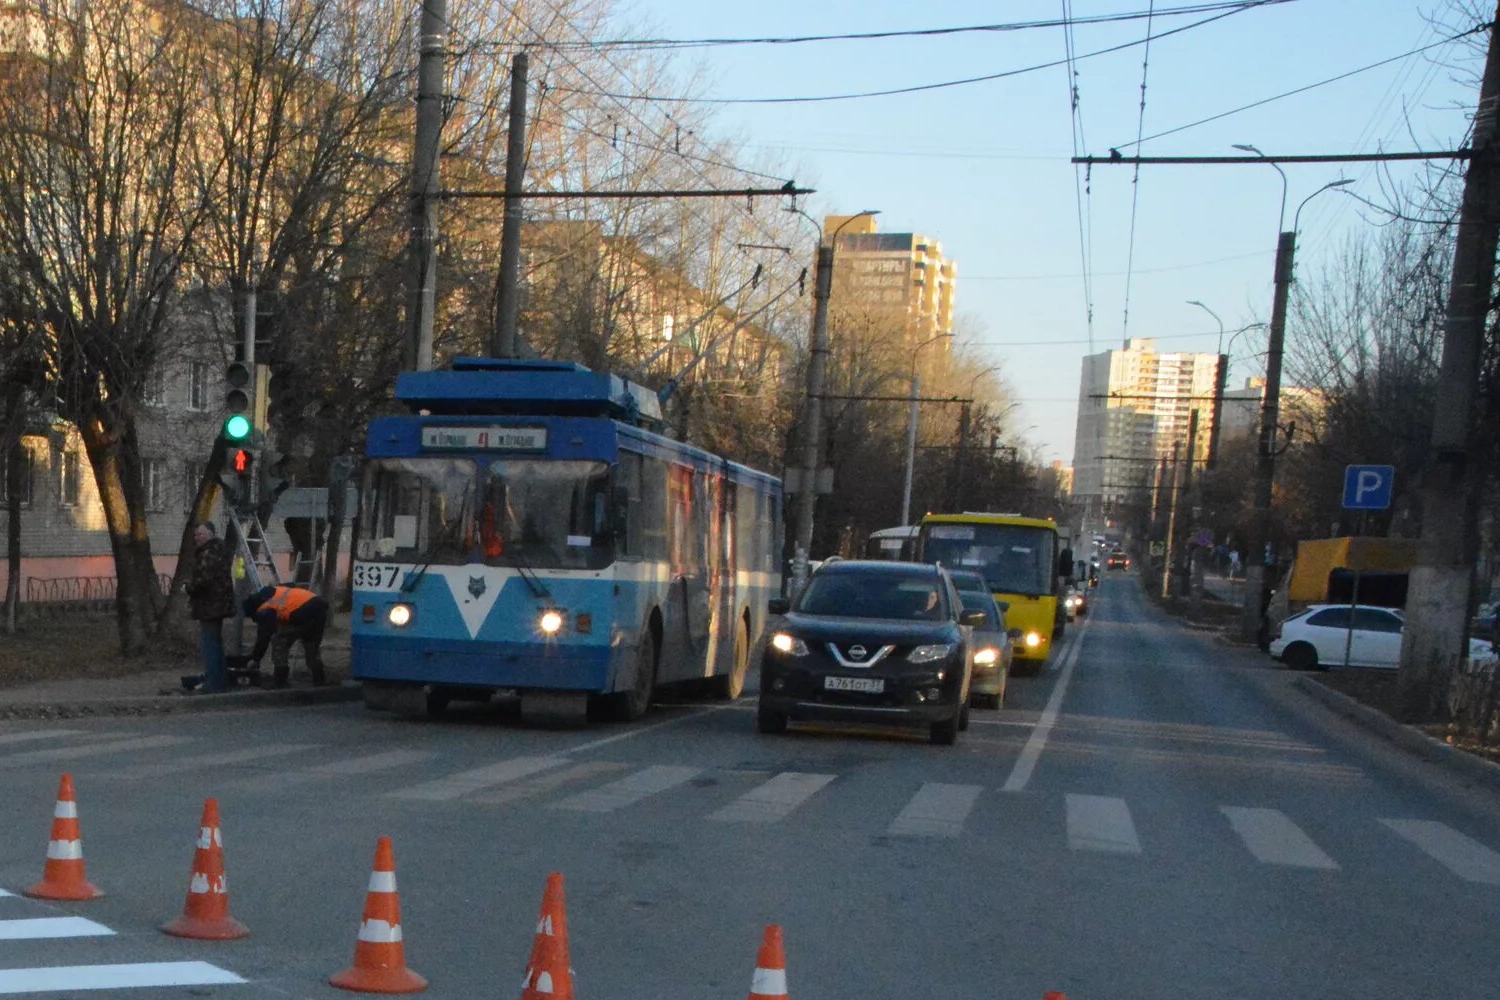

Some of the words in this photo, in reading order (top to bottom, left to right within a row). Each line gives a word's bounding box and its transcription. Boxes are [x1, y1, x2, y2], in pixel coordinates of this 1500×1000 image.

[478, 432, 489, 447] 4
[1356, 470, 1383, 503] P
[355, 565, 400, 588] 397
